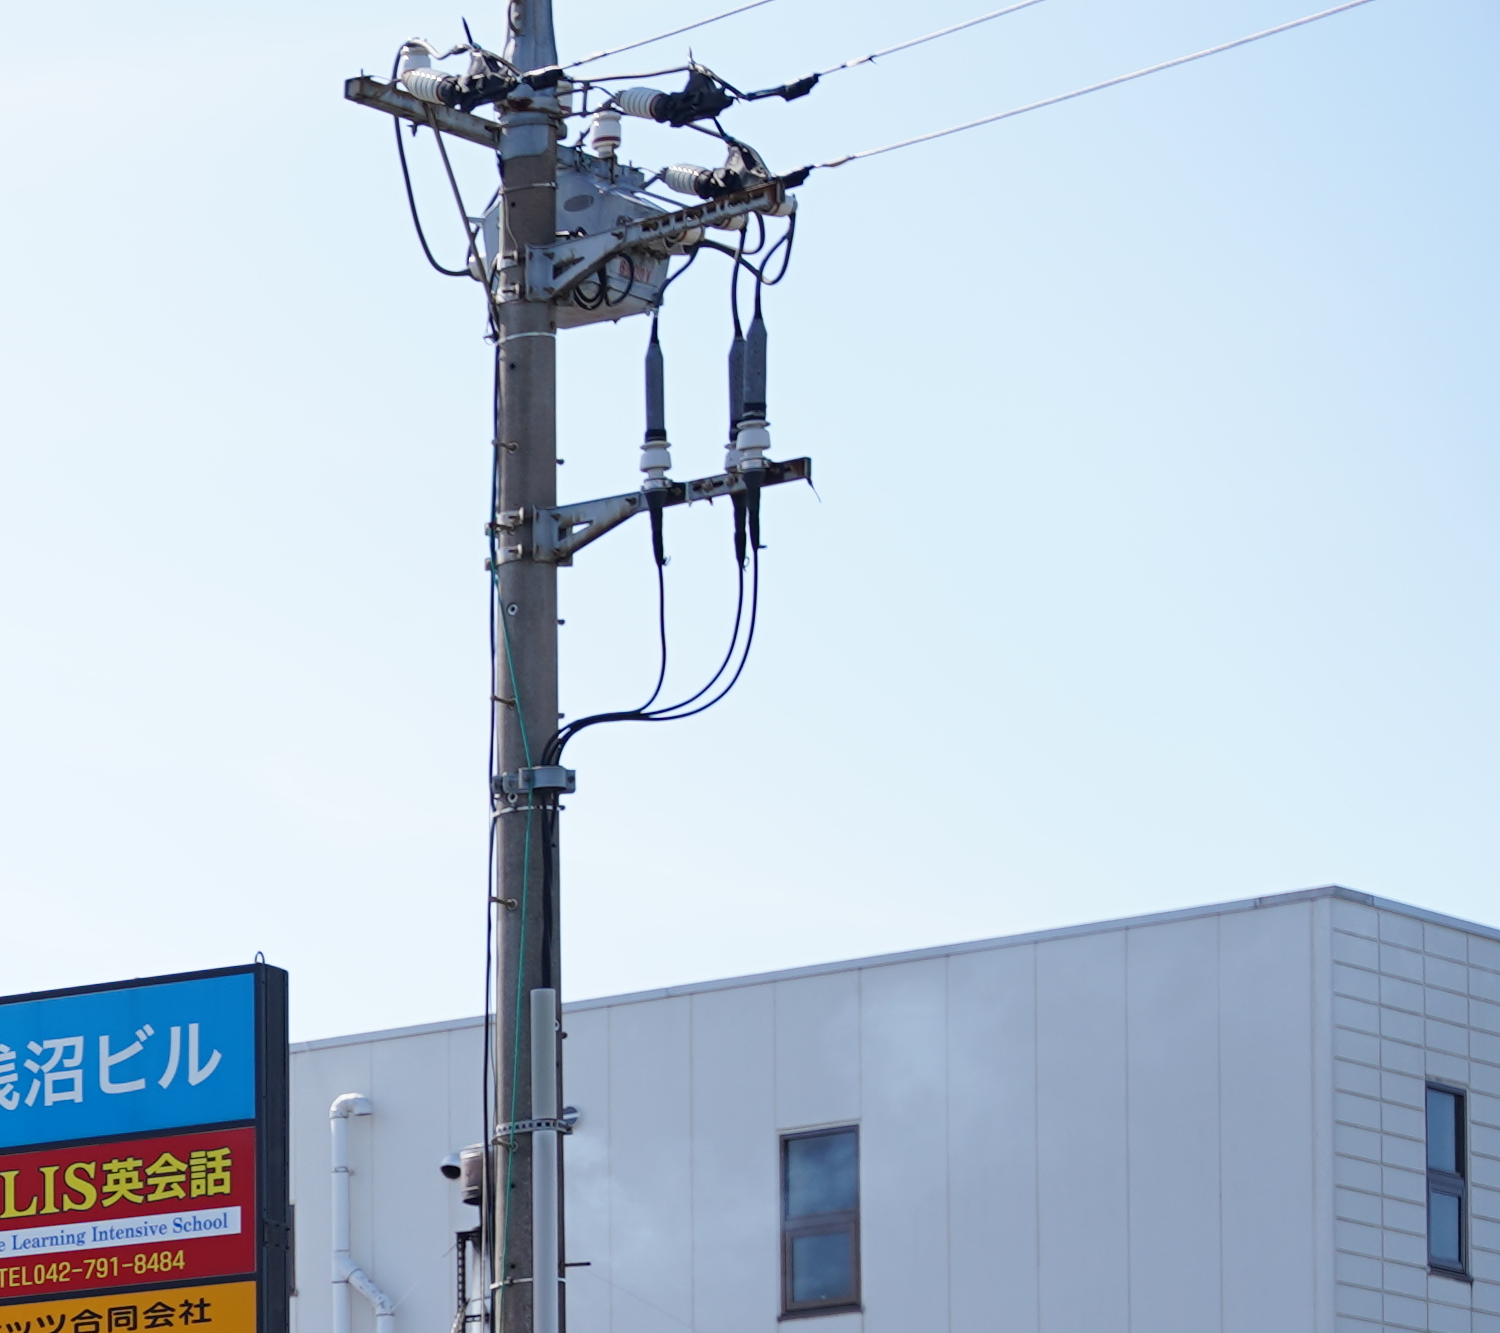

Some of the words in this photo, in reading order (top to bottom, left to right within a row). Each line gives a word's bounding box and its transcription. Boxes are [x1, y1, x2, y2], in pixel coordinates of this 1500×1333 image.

[11, 1229, 86, 1254] Learning
[91, 1219, 168, 1243] Intensive
[172, 1211, 229, 1235] School
